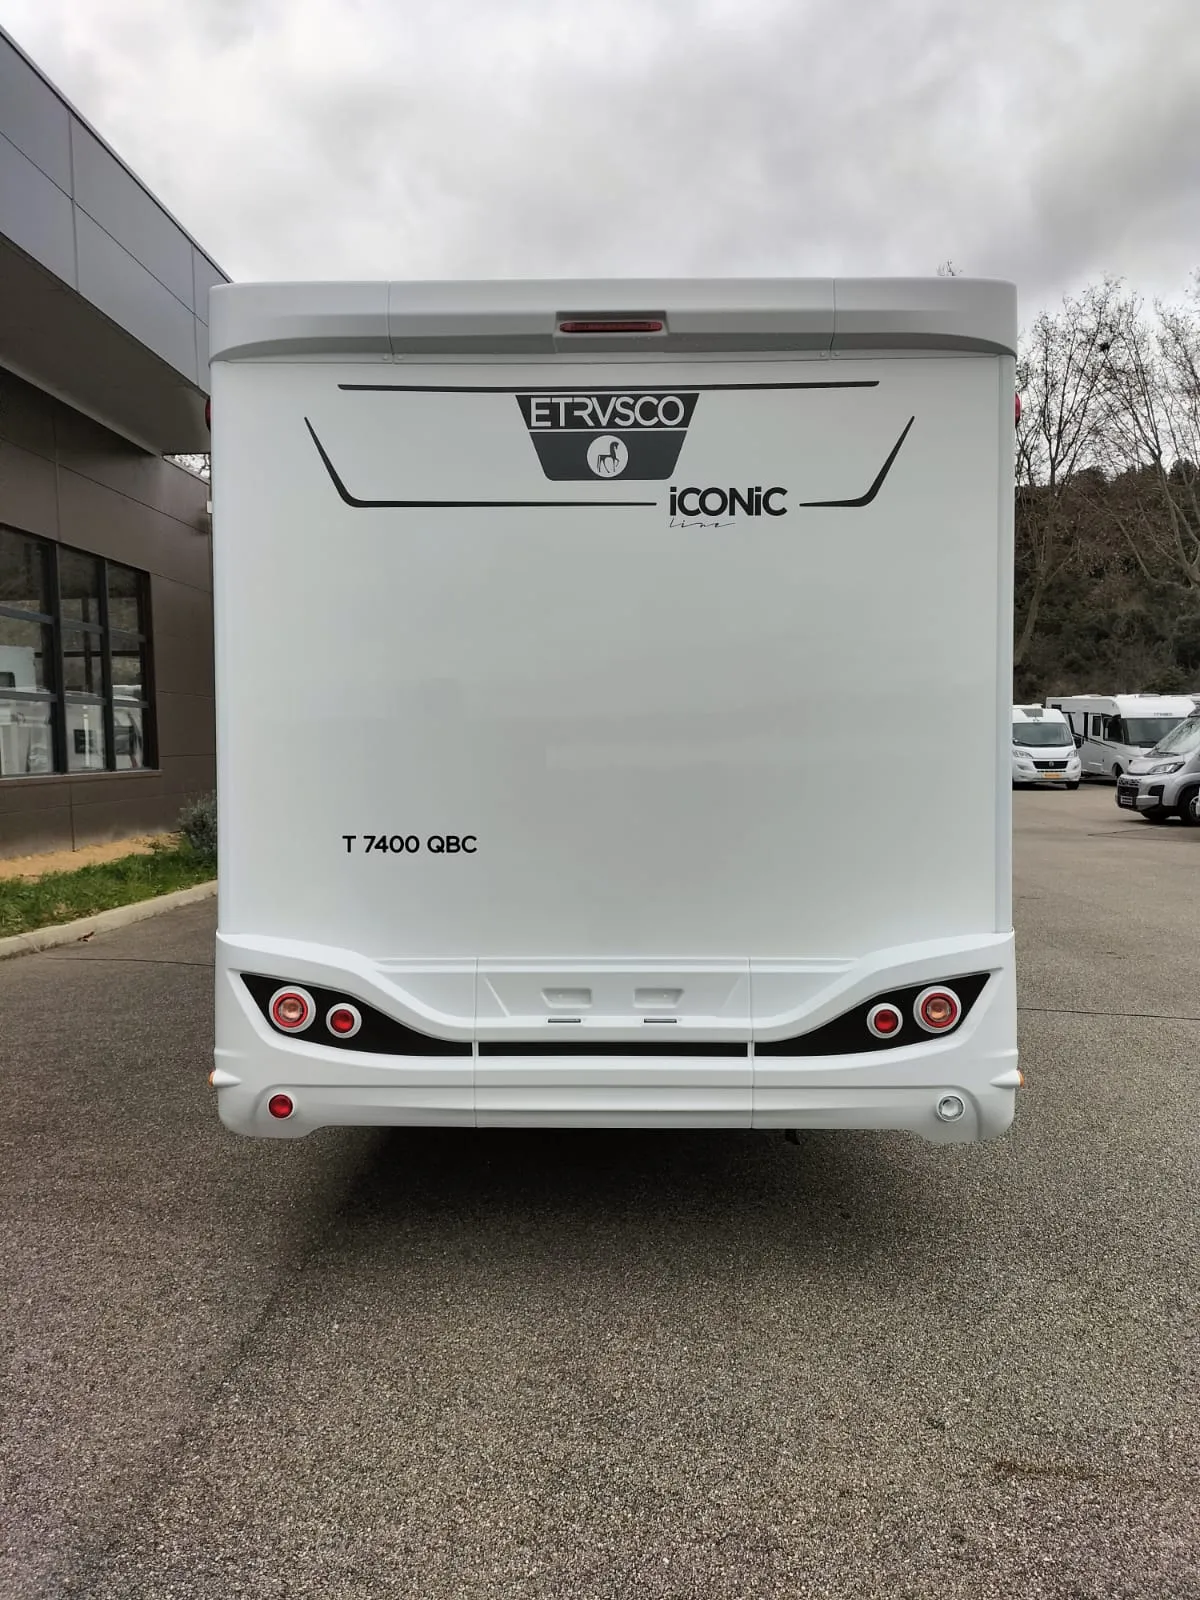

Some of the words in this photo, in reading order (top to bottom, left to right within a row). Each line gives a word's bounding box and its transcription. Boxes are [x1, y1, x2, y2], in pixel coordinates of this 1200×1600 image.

[530, 396, 685, 427] ETRVSCO
[342, 836, 356, 853] T
[363, 835, 420, 854] 7400
[426, 835, 478, 854] QBC
